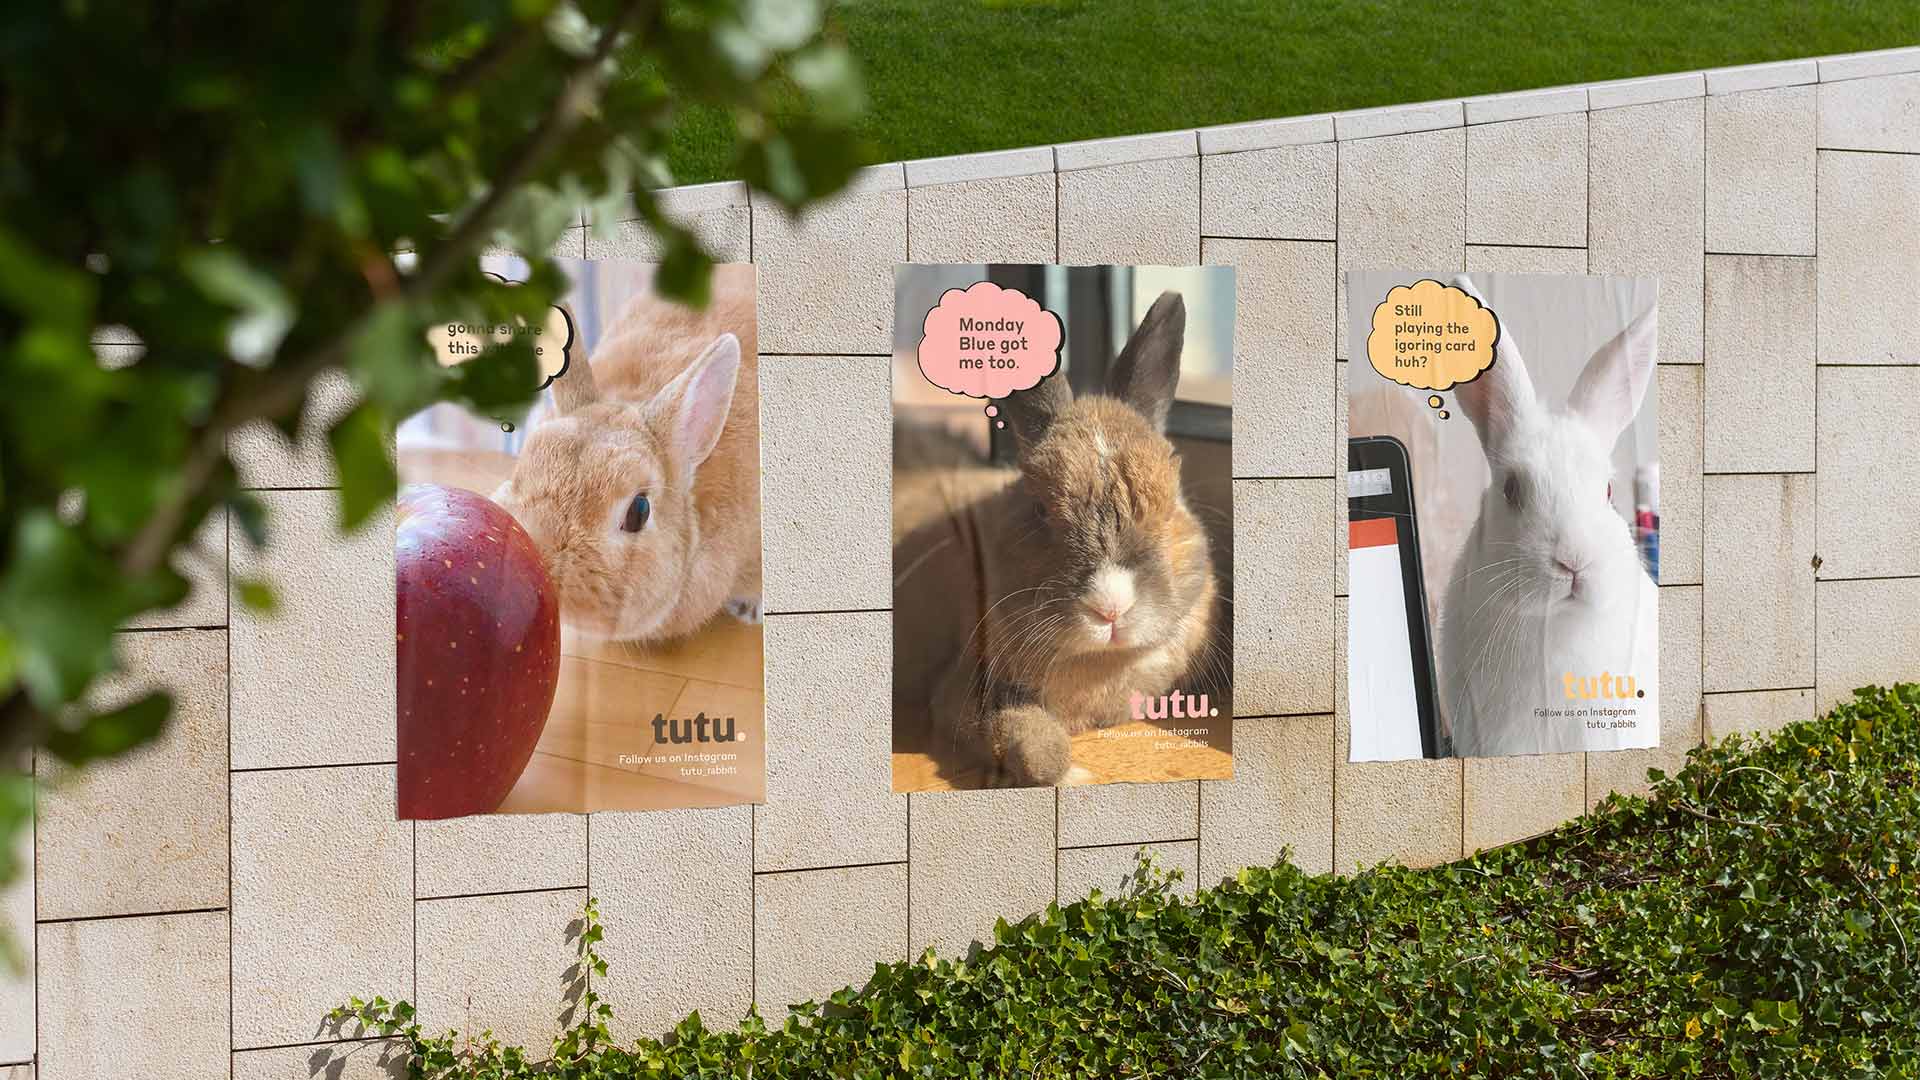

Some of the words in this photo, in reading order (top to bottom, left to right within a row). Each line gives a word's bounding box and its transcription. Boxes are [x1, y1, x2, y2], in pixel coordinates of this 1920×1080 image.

[1394, 304, 1422, 316] Still
[959, 317, 1024, 335] Monday
[1395, 322, 1443, 336] playing
[1446, 322, 1469, 333] the
[448, 340, 478, 354] this
[959, 337, 996, 351] Blue
[1000, 337, 1028, 354] got
[1394, 339, 1442, 353] igoring
[1445, 339, 1476, 351] card
[959, 358, 983, 369] me
[989, 355, 1020, 369] too.
[1395, 356, 1428, 368] huh?
[1563, 671, 1645, 699] tutu.
[1130, 689, 1218, 719] tutu.
[1534, 708, 1562, 717] Follow
[1564, 709, 1575, 717] us
[1577, 709, 1588, 717] on
[1590, 707, 1636, 718] Instagram
[651, 711, 746, 744] tutu.
[1586, 719, 1636, 730] tutu_rabbits
[1158, 727, 1209, 738] Instagram
[619, 754, 652, 764] Follow
[654, 755, 666, 763] us
[669, 755, 682, 763] on
[684, 753, 737, 764] Instagram
